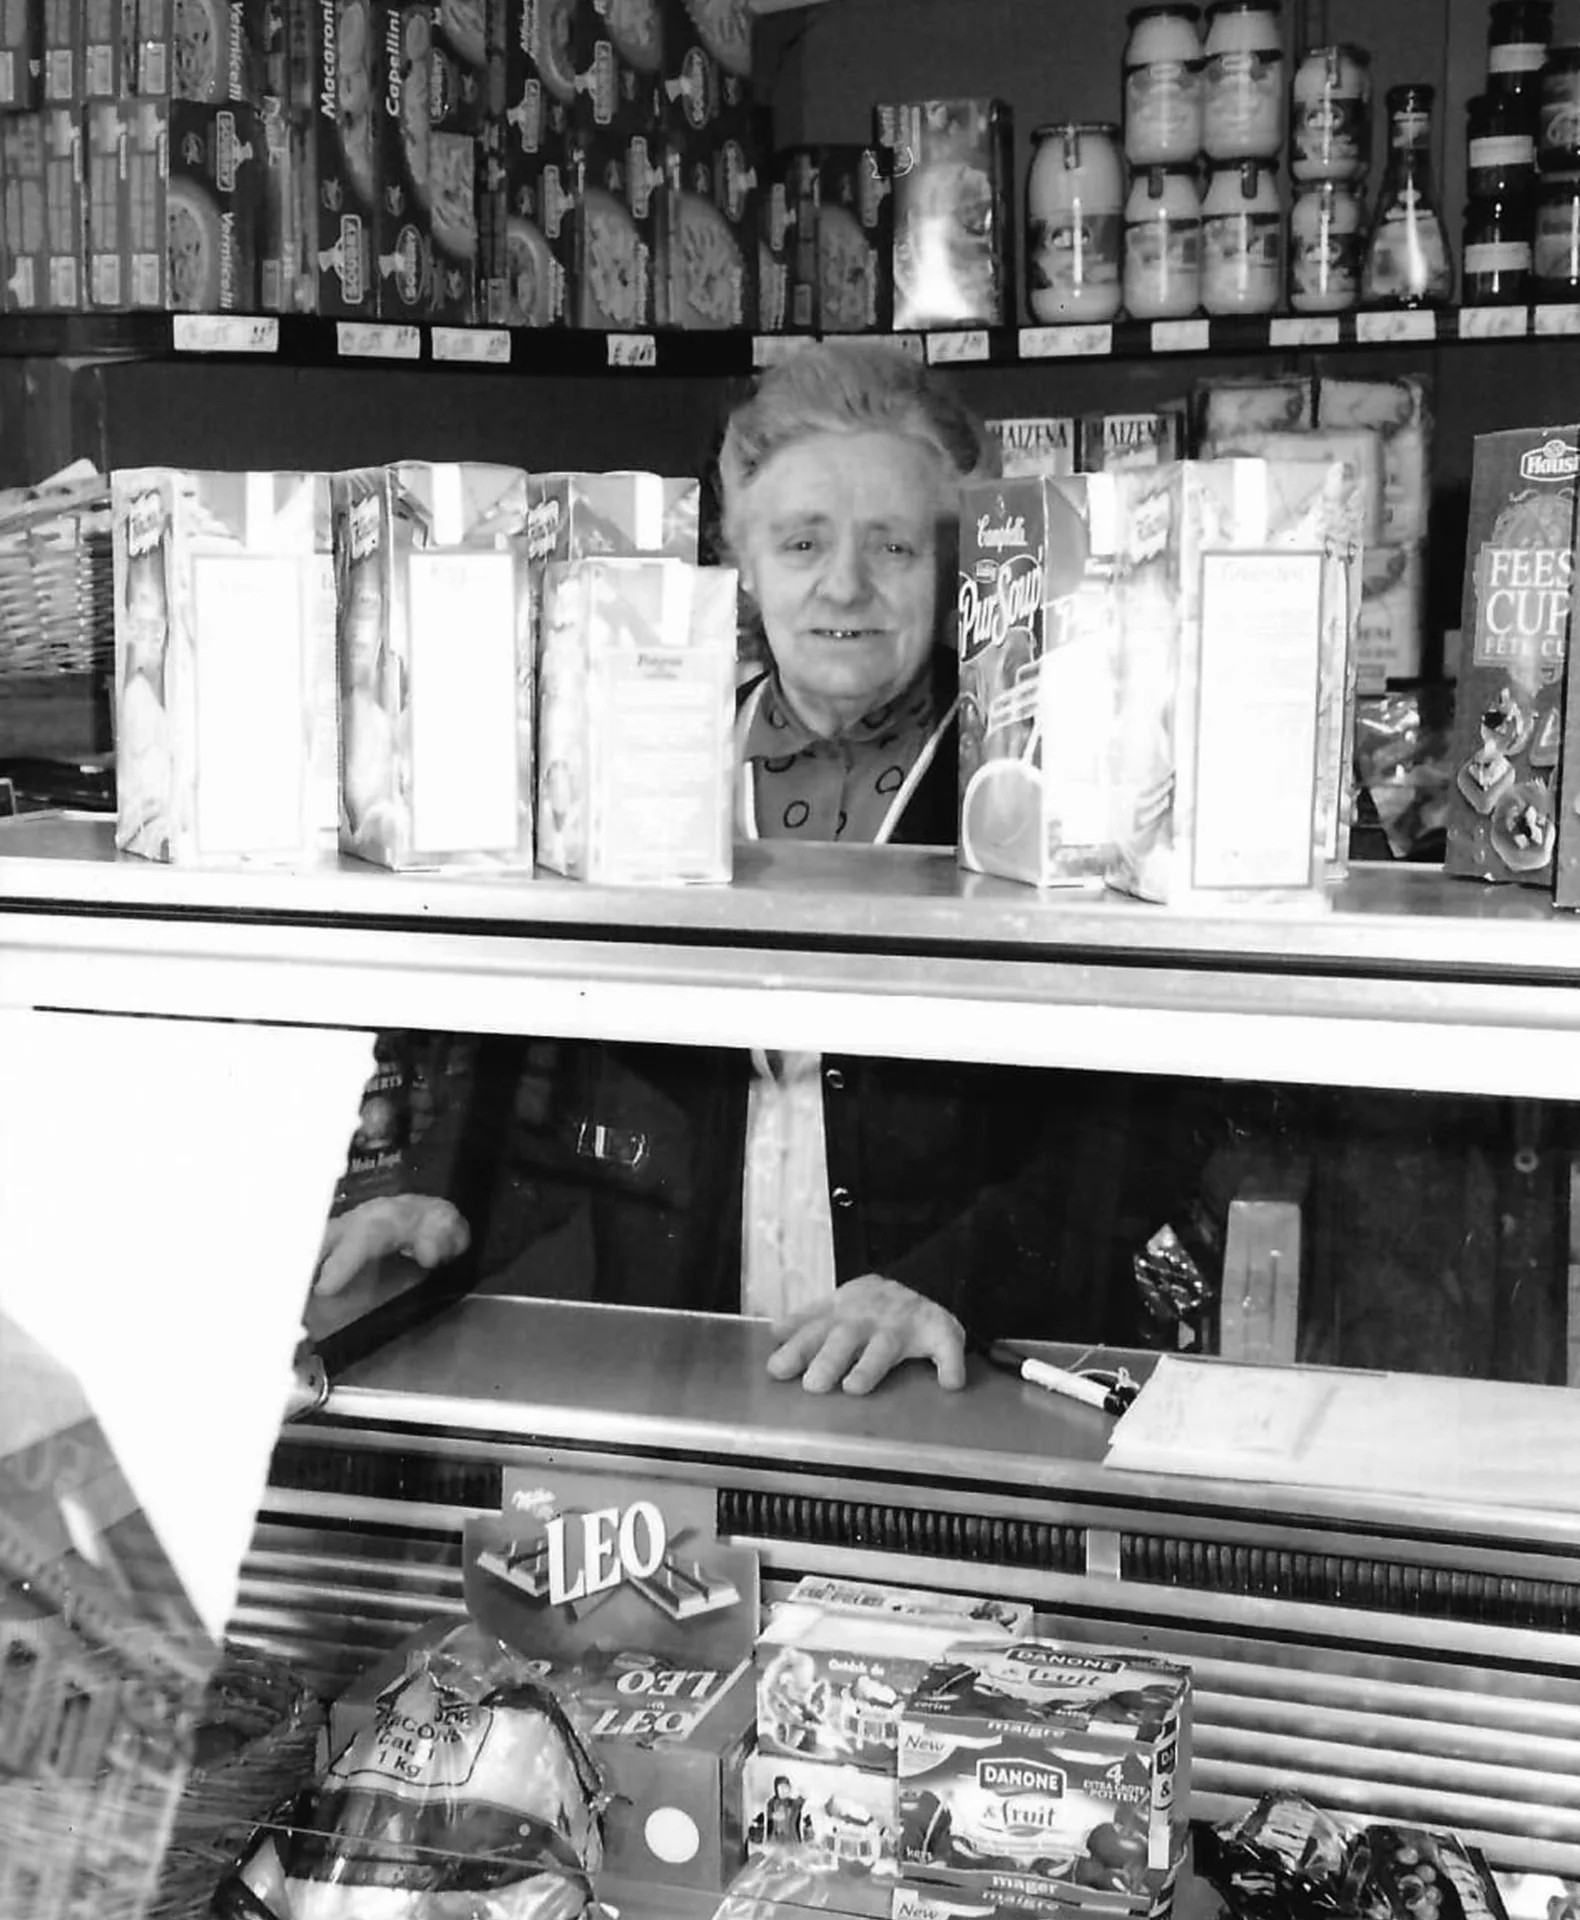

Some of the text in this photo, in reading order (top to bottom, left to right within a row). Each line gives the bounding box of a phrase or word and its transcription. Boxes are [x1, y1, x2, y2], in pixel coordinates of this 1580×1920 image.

[321, 0, 336, 119] Macaroni
[386, 9, 402, 117] Capellini
[545, 1500, 666, 1606] LEO
[1017, 1650, 1113, 1671] DANONE
[590, 1708, 692, 1736] LEO
[904, 1735, 946, 1753] New
[394, 1756, 422, 1779] kg
[985, 1766, 1059, 1791] DANONE
[1106, 1763, 1124, 1784] 4
[1002, 1797, 1056, 1829] fruit
[992, 1874, 1059, 1894] mager
[897, 1899, 940, 1920] New
